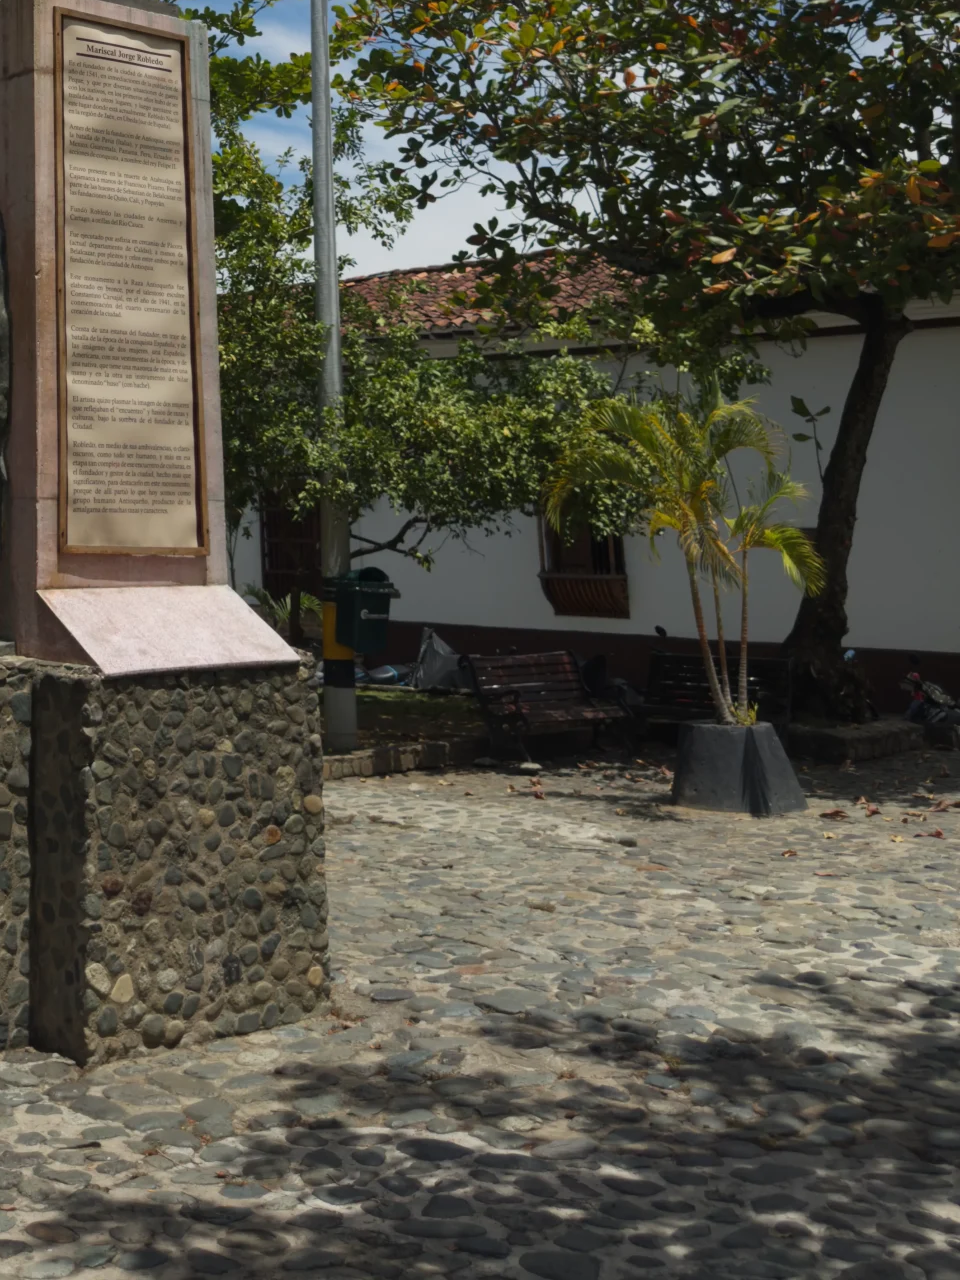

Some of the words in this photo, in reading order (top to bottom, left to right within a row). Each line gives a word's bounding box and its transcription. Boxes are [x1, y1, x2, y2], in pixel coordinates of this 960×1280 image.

[86, 43, 116, 57] Mariscal
[118, 49, 135, 63] Jorge
[137, 53, 163, 66] Robledo
[90, 207, 111, 216] Robledo
